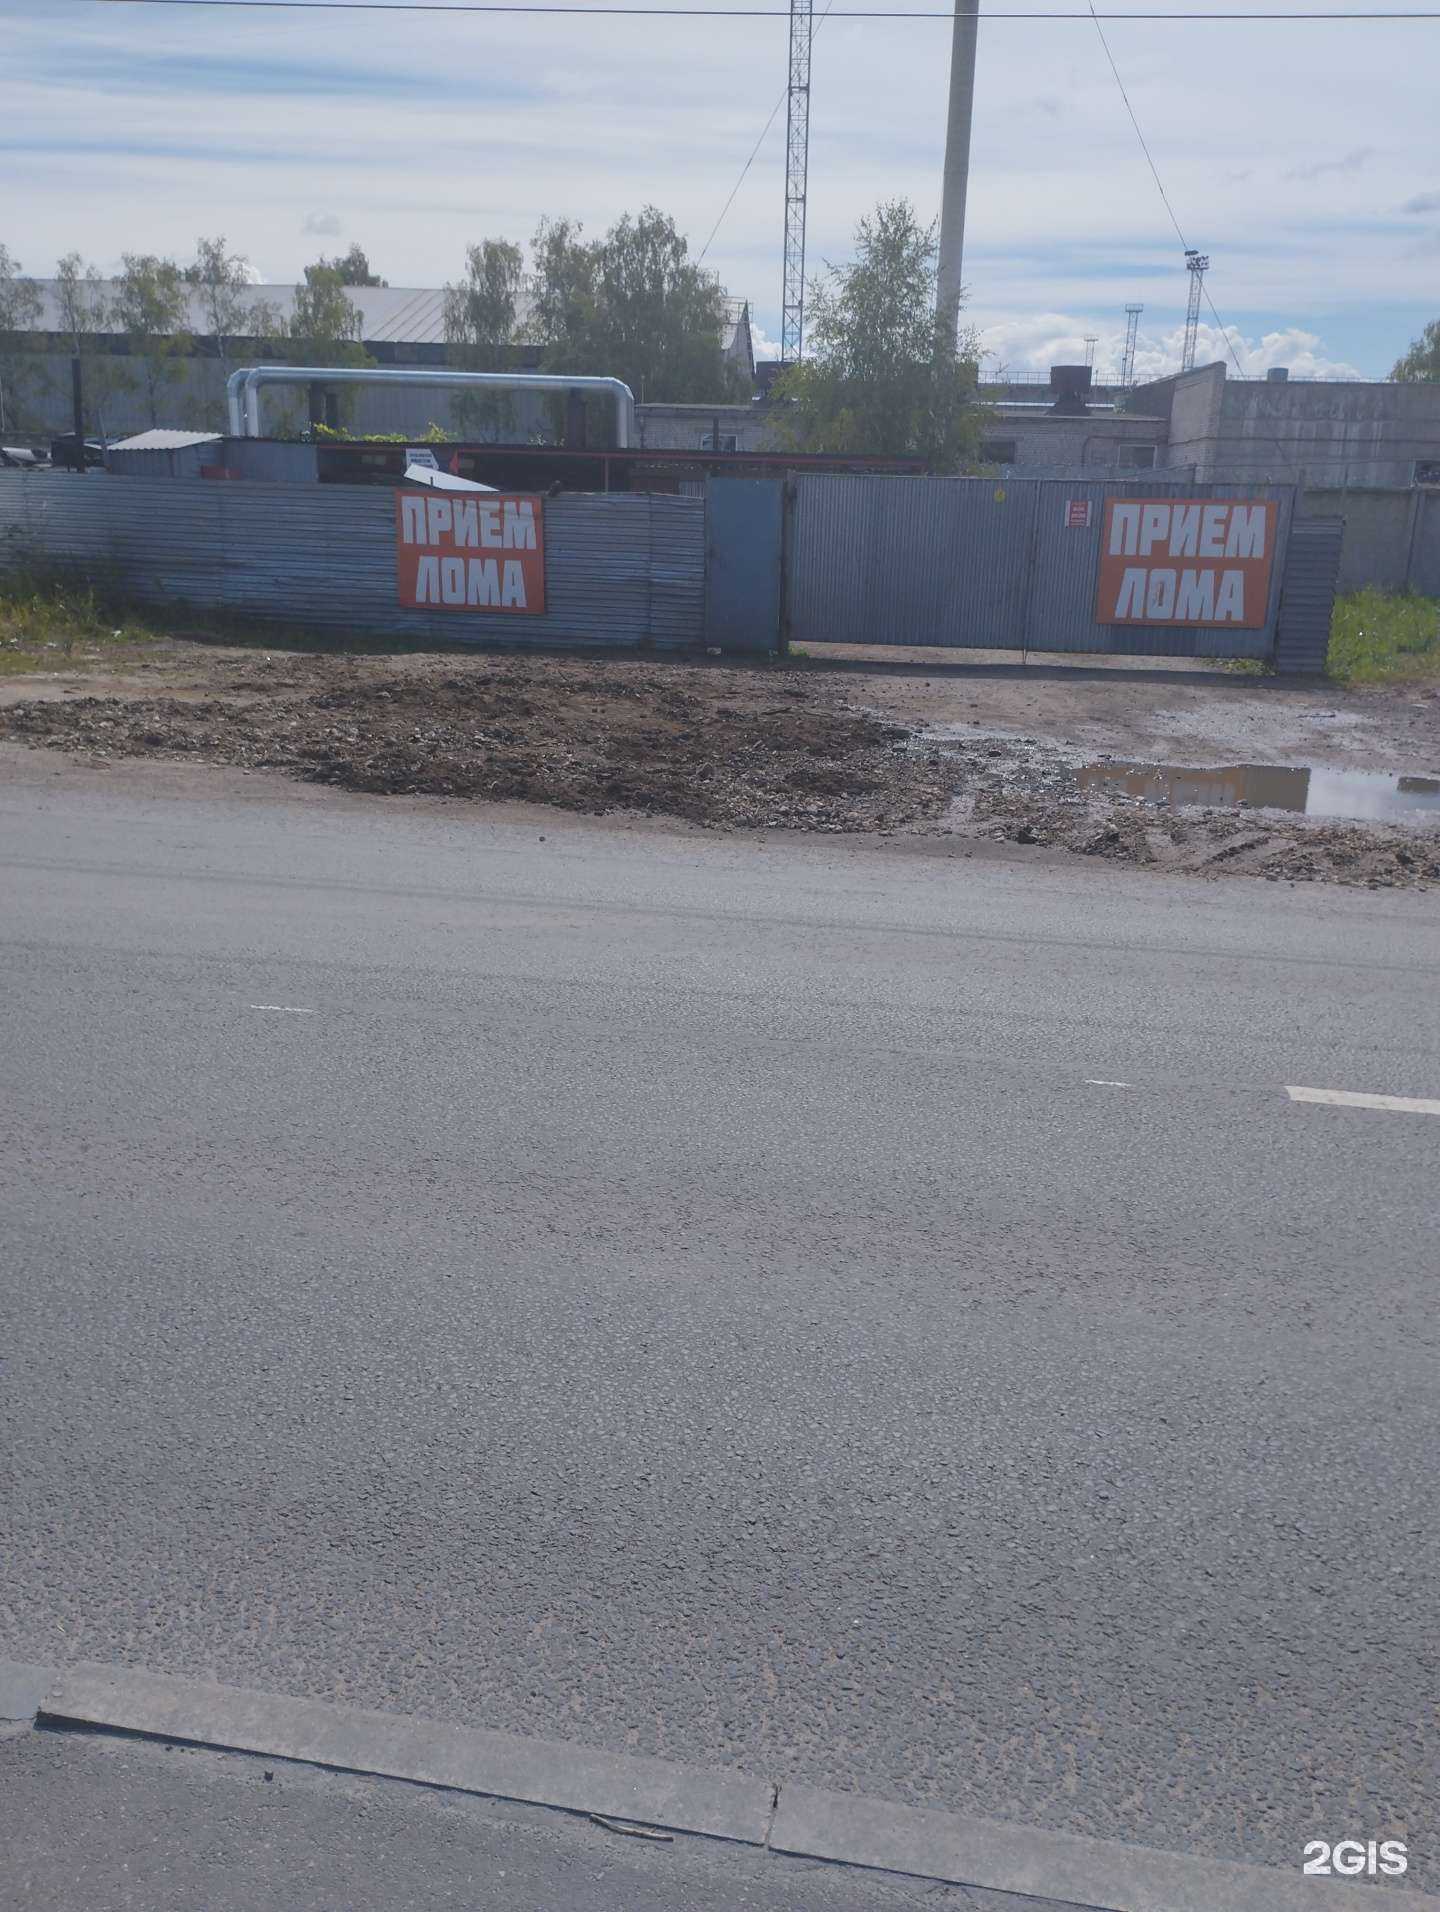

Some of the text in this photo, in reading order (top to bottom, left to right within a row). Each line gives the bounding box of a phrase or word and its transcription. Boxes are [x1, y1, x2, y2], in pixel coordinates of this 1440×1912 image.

[402, 496, 537, 550] ПРИЕМ
[1109, 503, 1267, 559] ПРИЕМ
[415, 555, 528, 608] ЛОМА
[1114, 567, 1245, 622] ЛОМА
